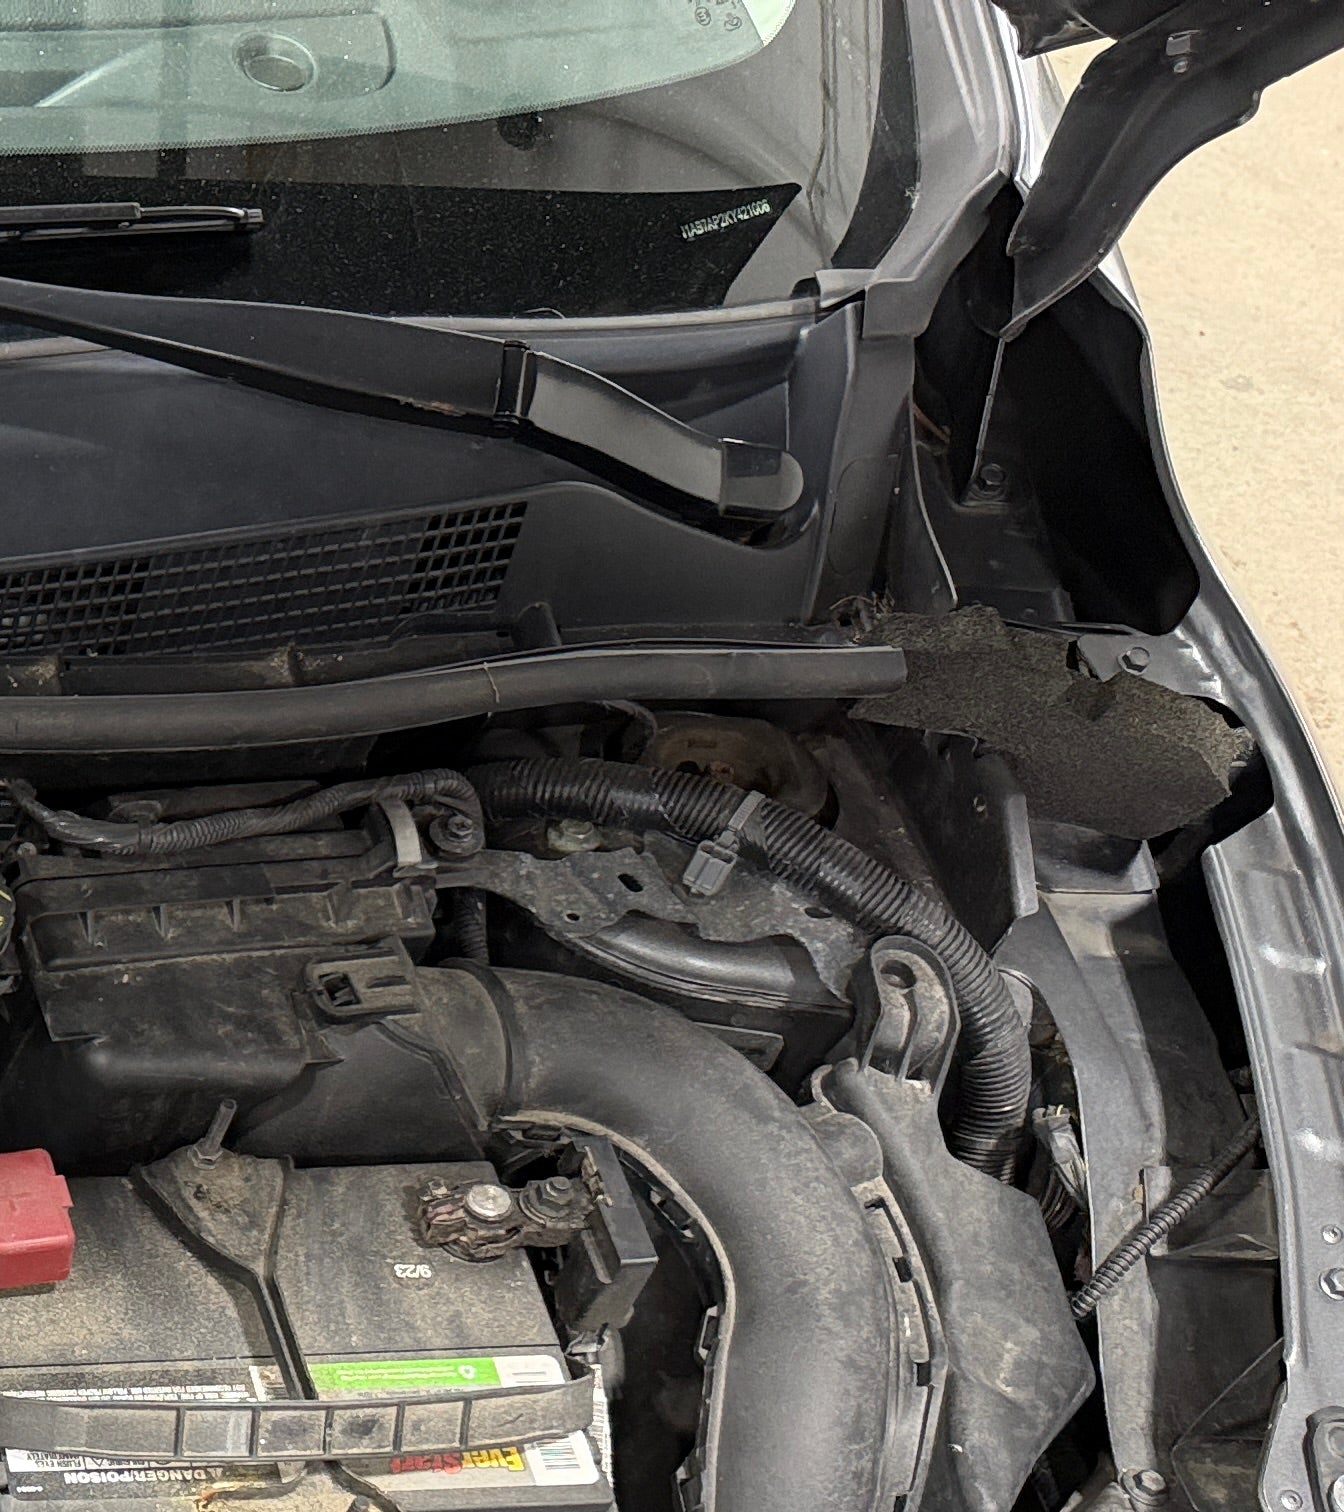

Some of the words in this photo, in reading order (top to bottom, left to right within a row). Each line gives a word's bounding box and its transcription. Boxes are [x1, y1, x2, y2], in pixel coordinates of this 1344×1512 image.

[394, 1263, 432, 1279] 9/23
[389, 1446, 525, 1475] EverStart
[64, 1468, 207, 1485] DANGER/POISON
